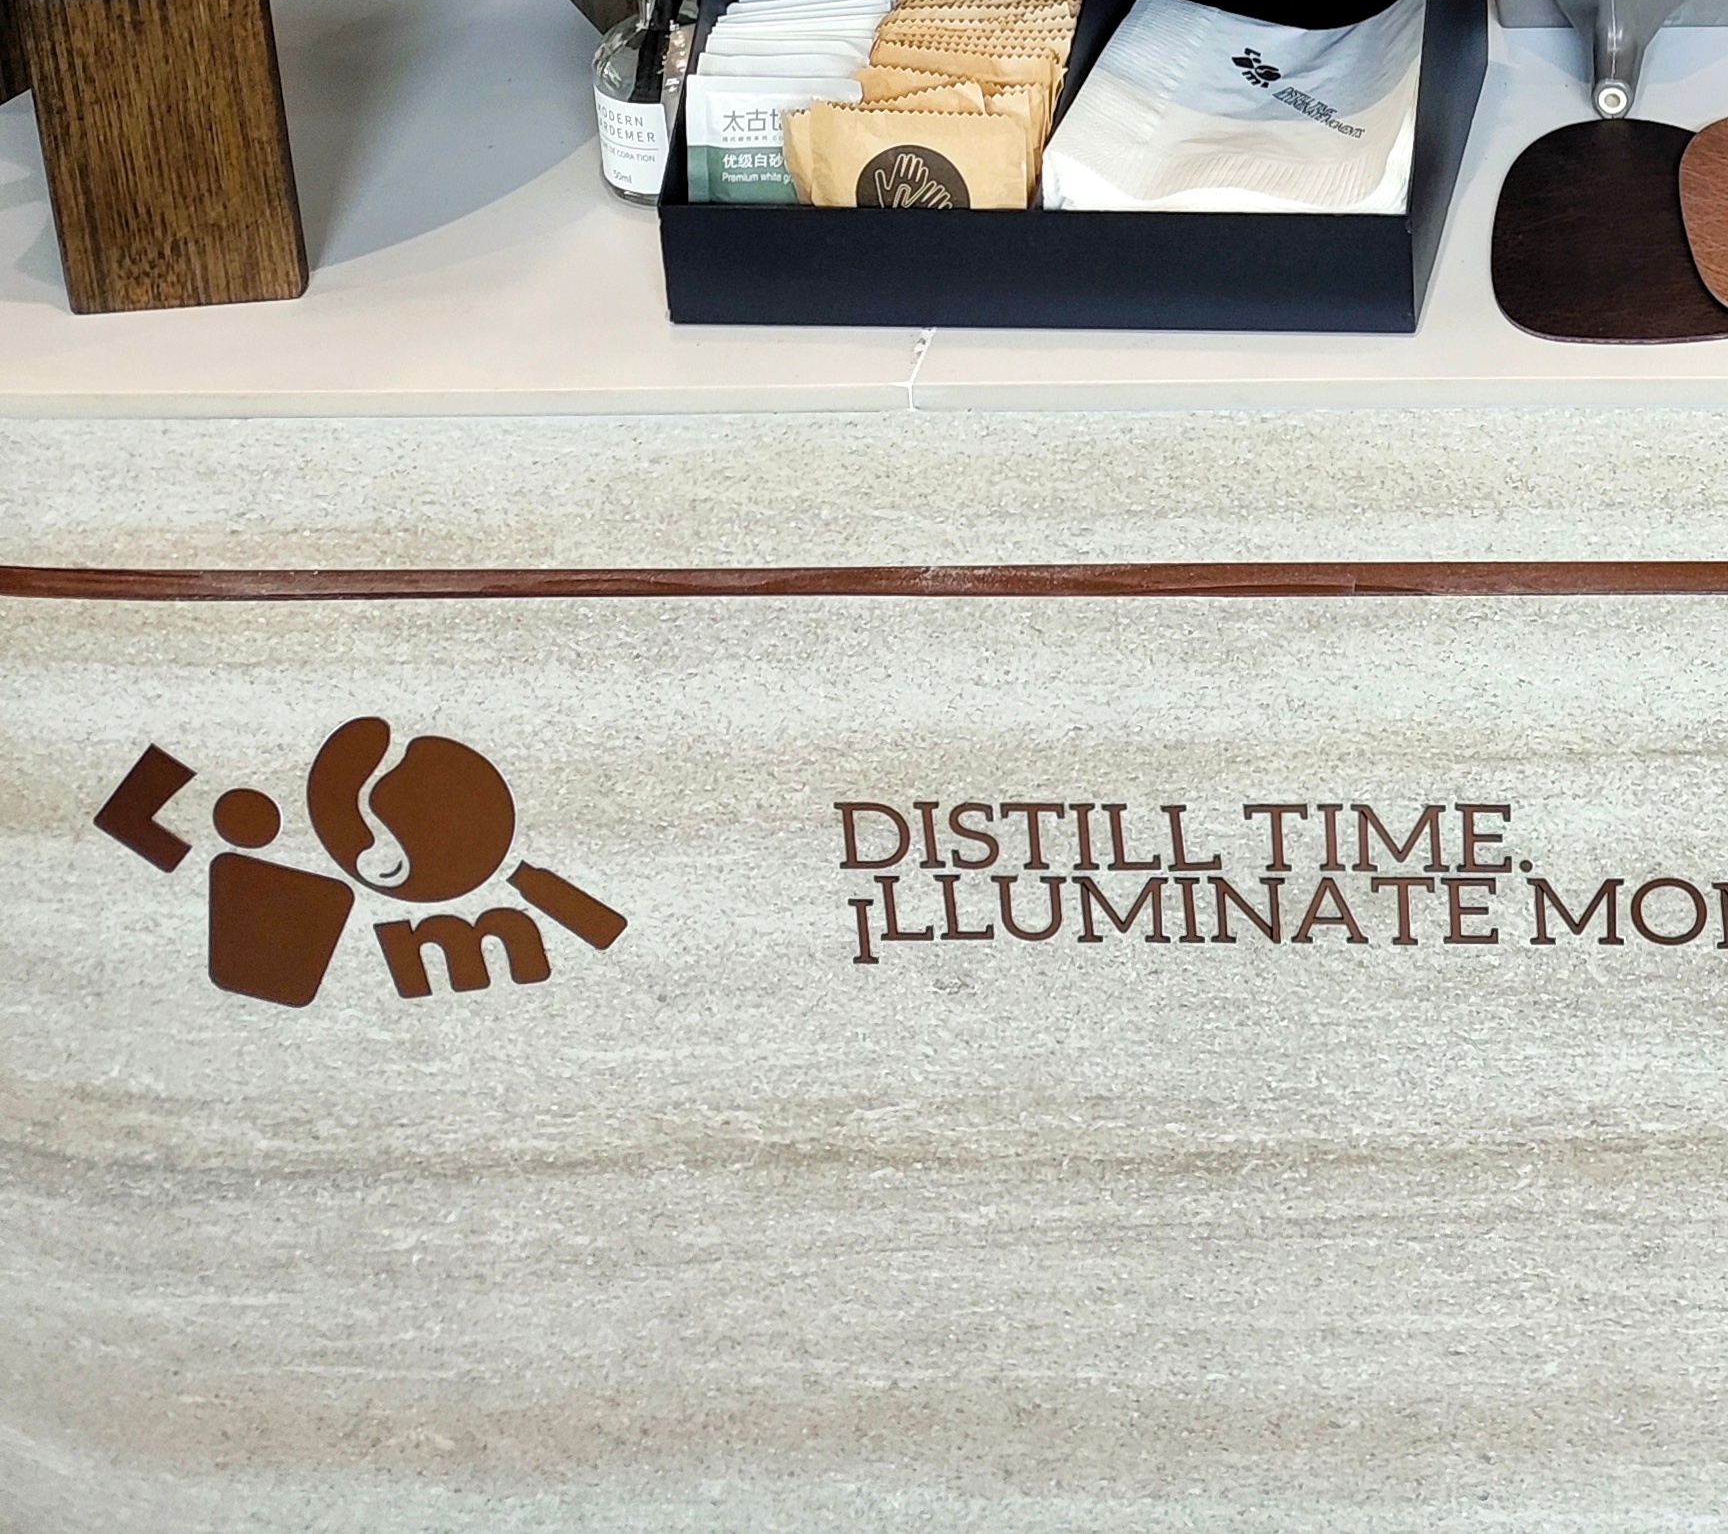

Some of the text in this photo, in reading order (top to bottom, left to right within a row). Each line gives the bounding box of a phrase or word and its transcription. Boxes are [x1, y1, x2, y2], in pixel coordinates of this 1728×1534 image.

[722, 108, 783, 132] 太古t
[722, 152, 783, 169] 优级白砂
[722, 172, 759, 183] Premium
[760, 172, 781, 182] white
[834, 801, 1534, 874] DISTILL TIME.
[847, 874, 1500, 965] ILLUMINATE
